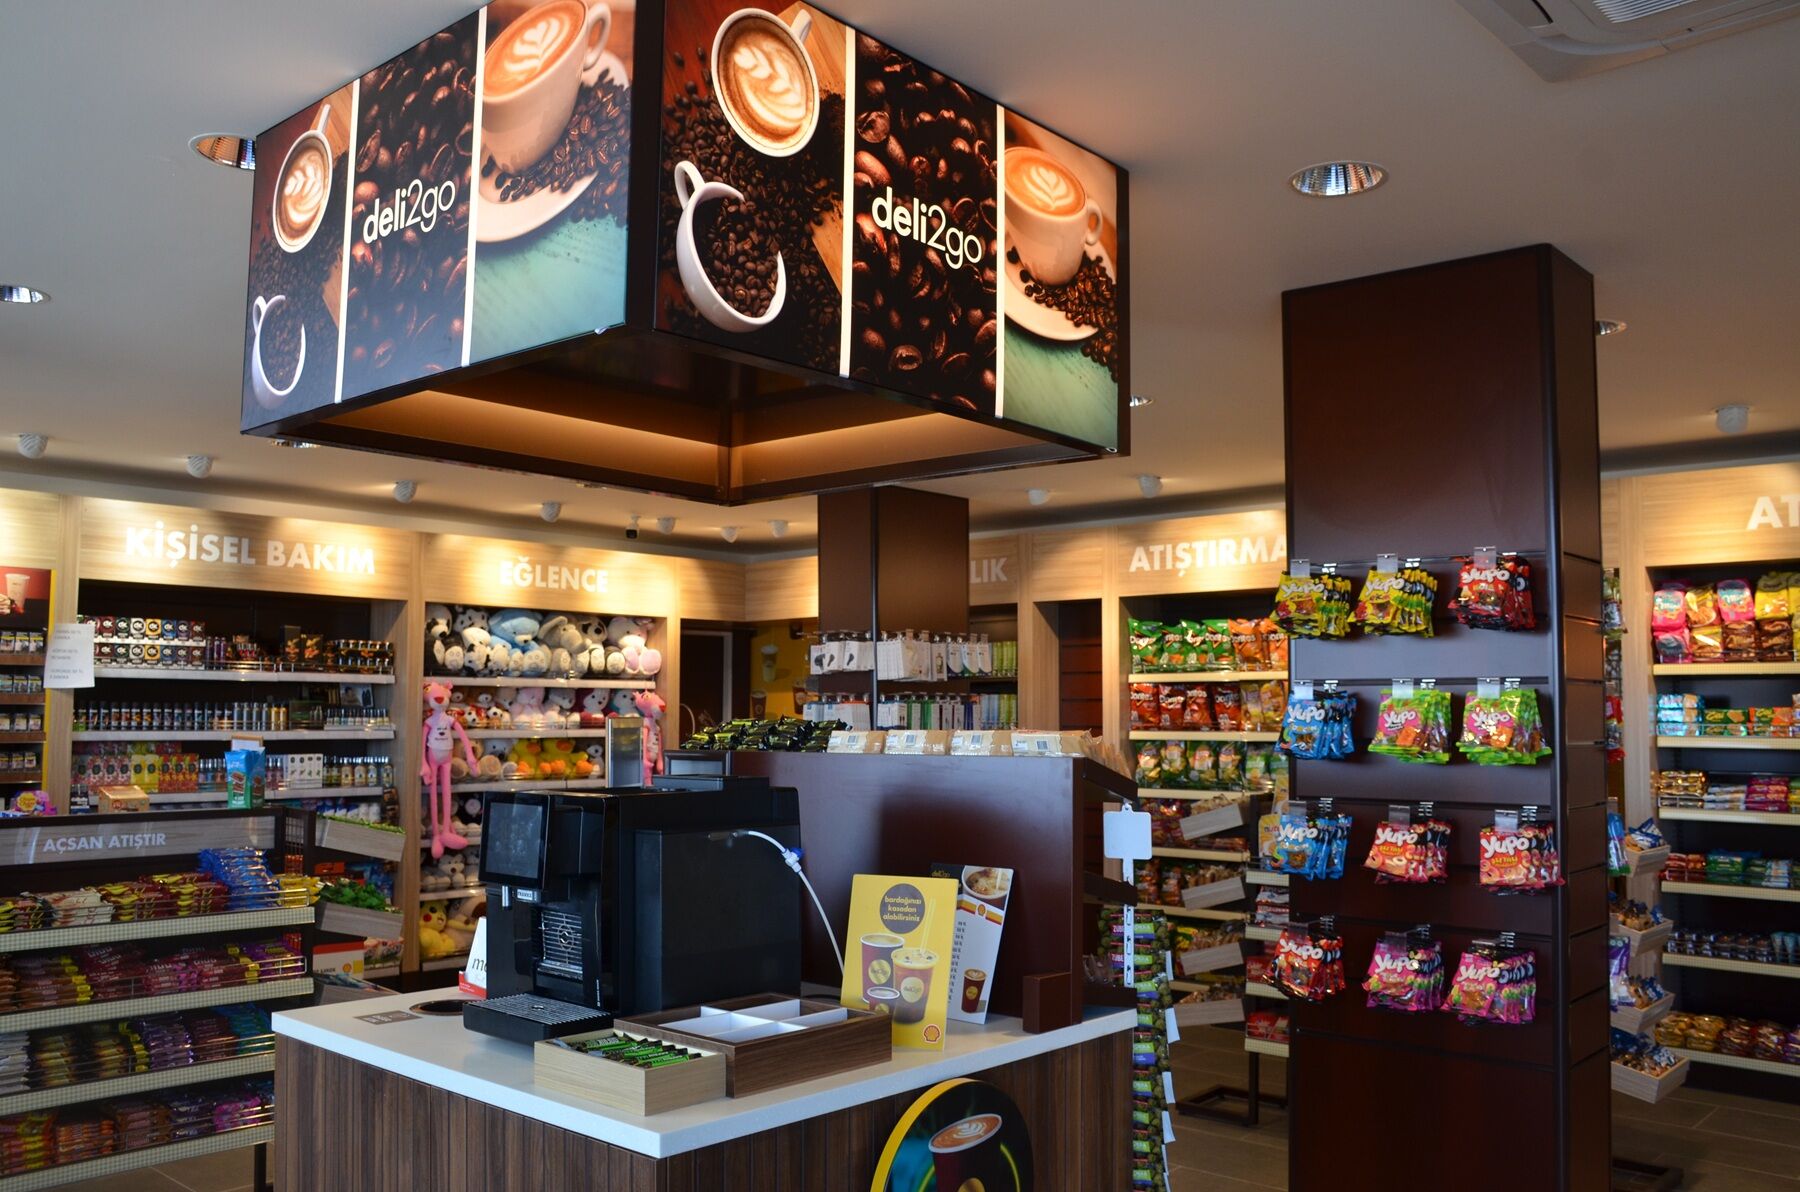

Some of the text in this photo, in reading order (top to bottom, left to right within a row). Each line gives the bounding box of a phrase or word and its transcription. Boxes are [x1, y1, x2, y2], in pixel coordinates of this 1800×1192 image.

[363, 179, 456, 244] deli2go
[872, 186, 982, 270] deli2go
[125, 521, 376, 575] KİŞİSEL BAKIM
[500, 556, 609, 593] EĞLENCE
[43, 833, 166, 855] AÇSAN ATIŞTIR
[882, 912, 920, 922] alabilirsiniz
[887, 904, 917, 913] kasadan
